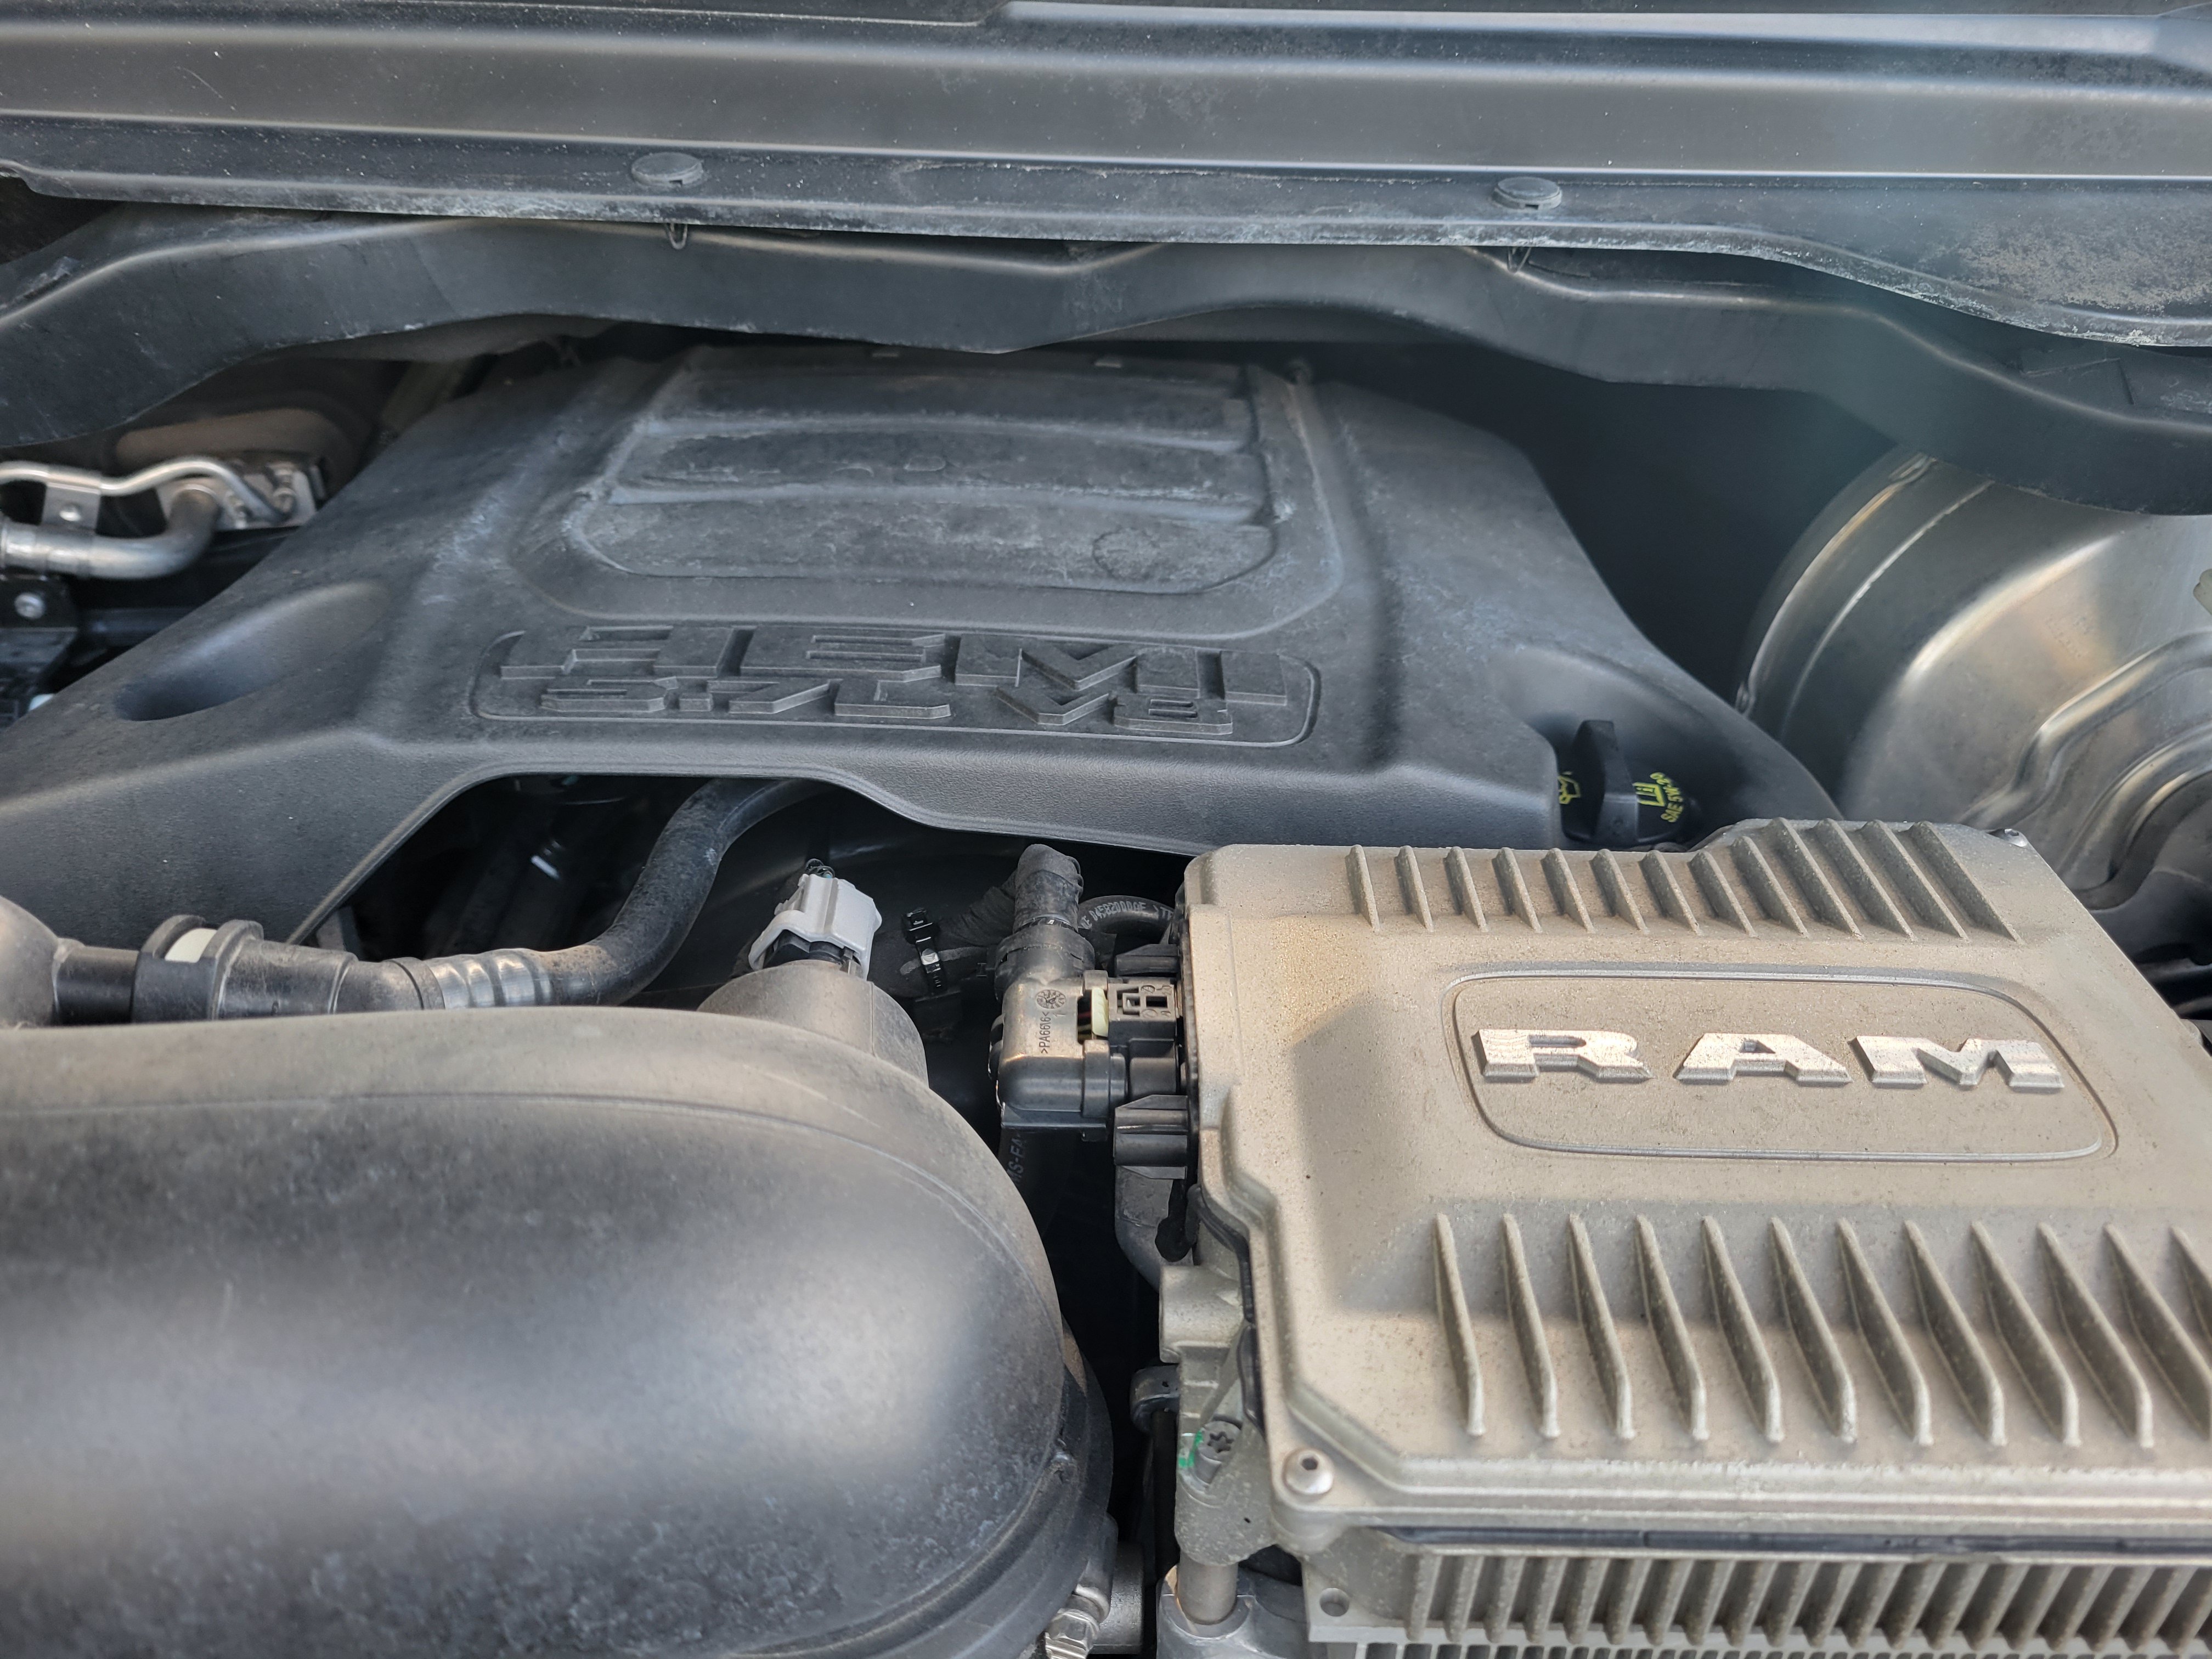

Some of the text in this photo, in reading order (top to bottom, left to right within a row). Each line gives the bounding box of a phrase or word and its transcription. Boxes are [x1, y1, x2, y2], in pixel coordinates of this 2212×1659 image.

[500, 625, 1287, 706] HEMI
[992, 686, 1233, 735] V8
[1661, 802, 1684, 823] SAE
[1471, 1028, 2066, 1090] RAM
